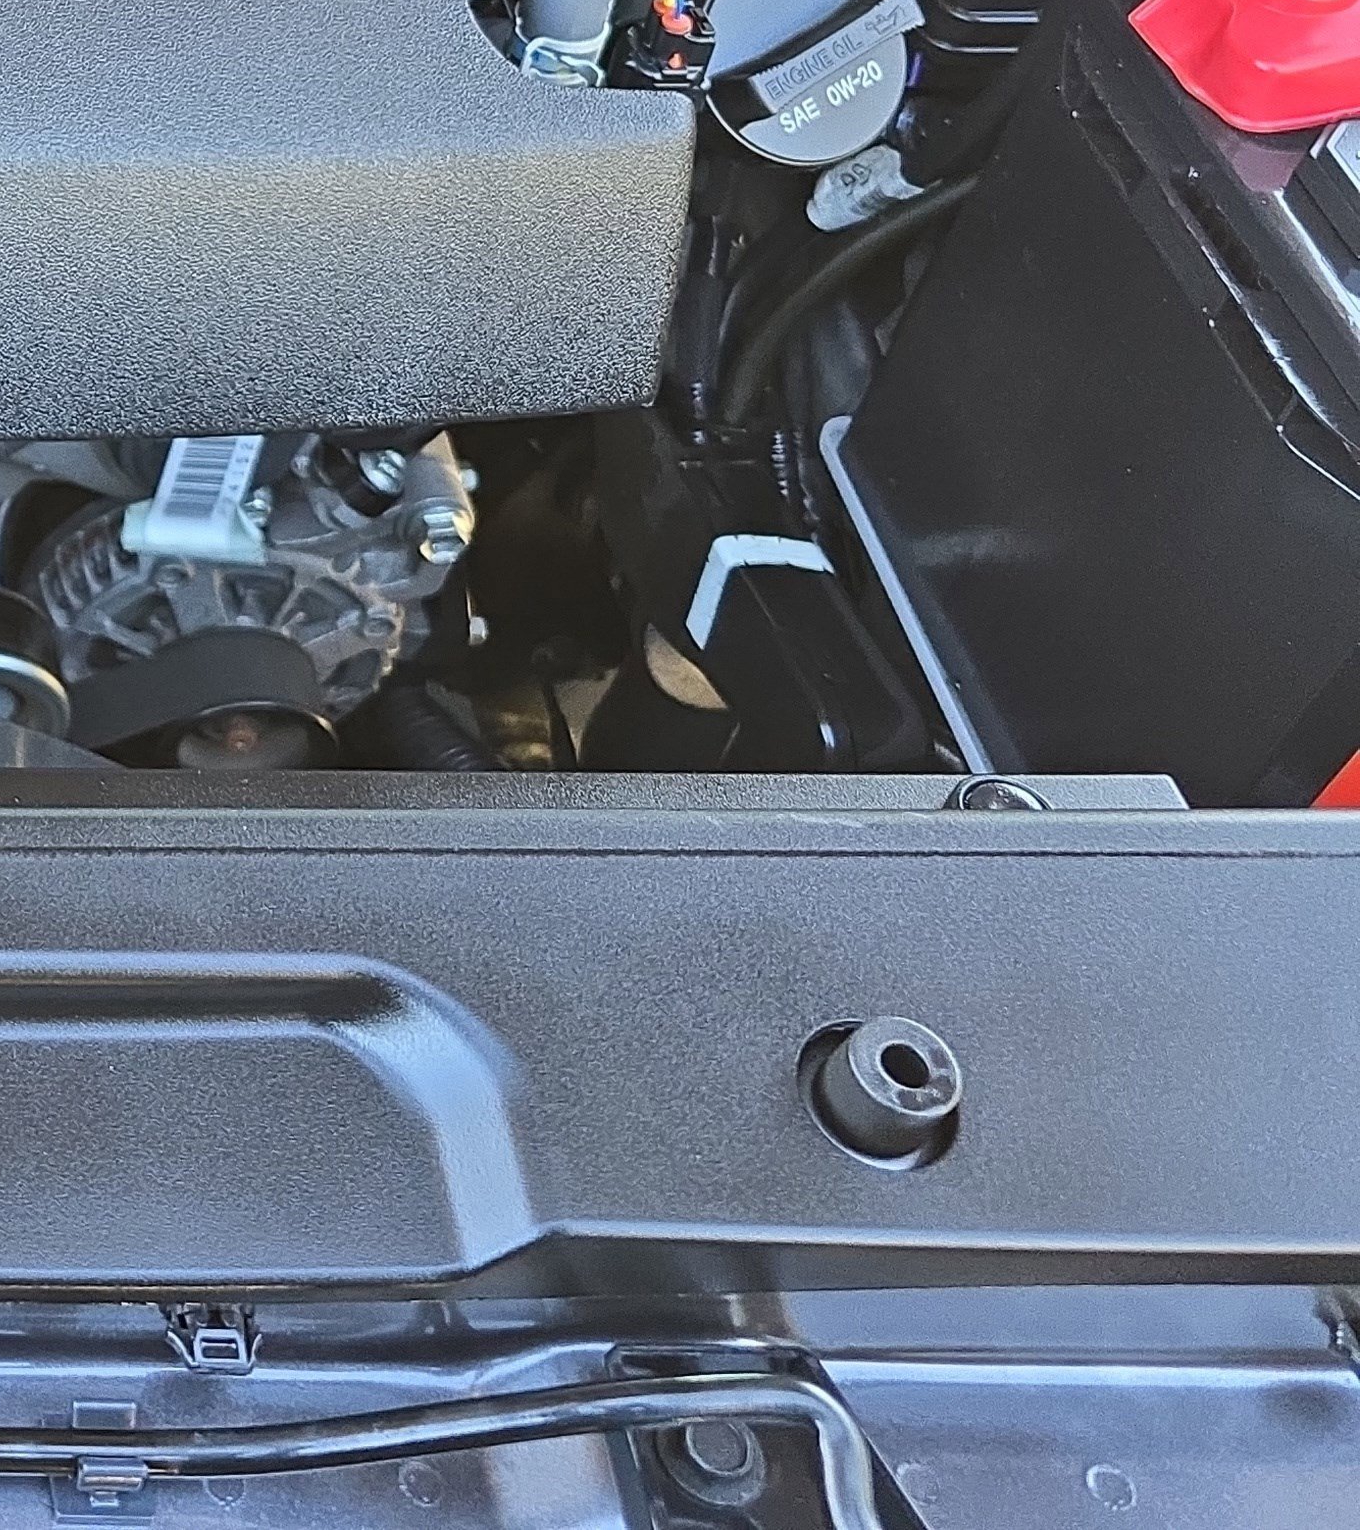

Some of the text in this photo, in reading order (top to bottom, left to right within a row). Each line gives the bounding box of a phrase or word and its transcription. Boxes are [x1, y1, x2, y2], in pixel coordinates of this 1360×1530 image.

[764, 33, 864, 101] ENGINE OIL
[779, 60, 883, 135] SAE 0W-20
